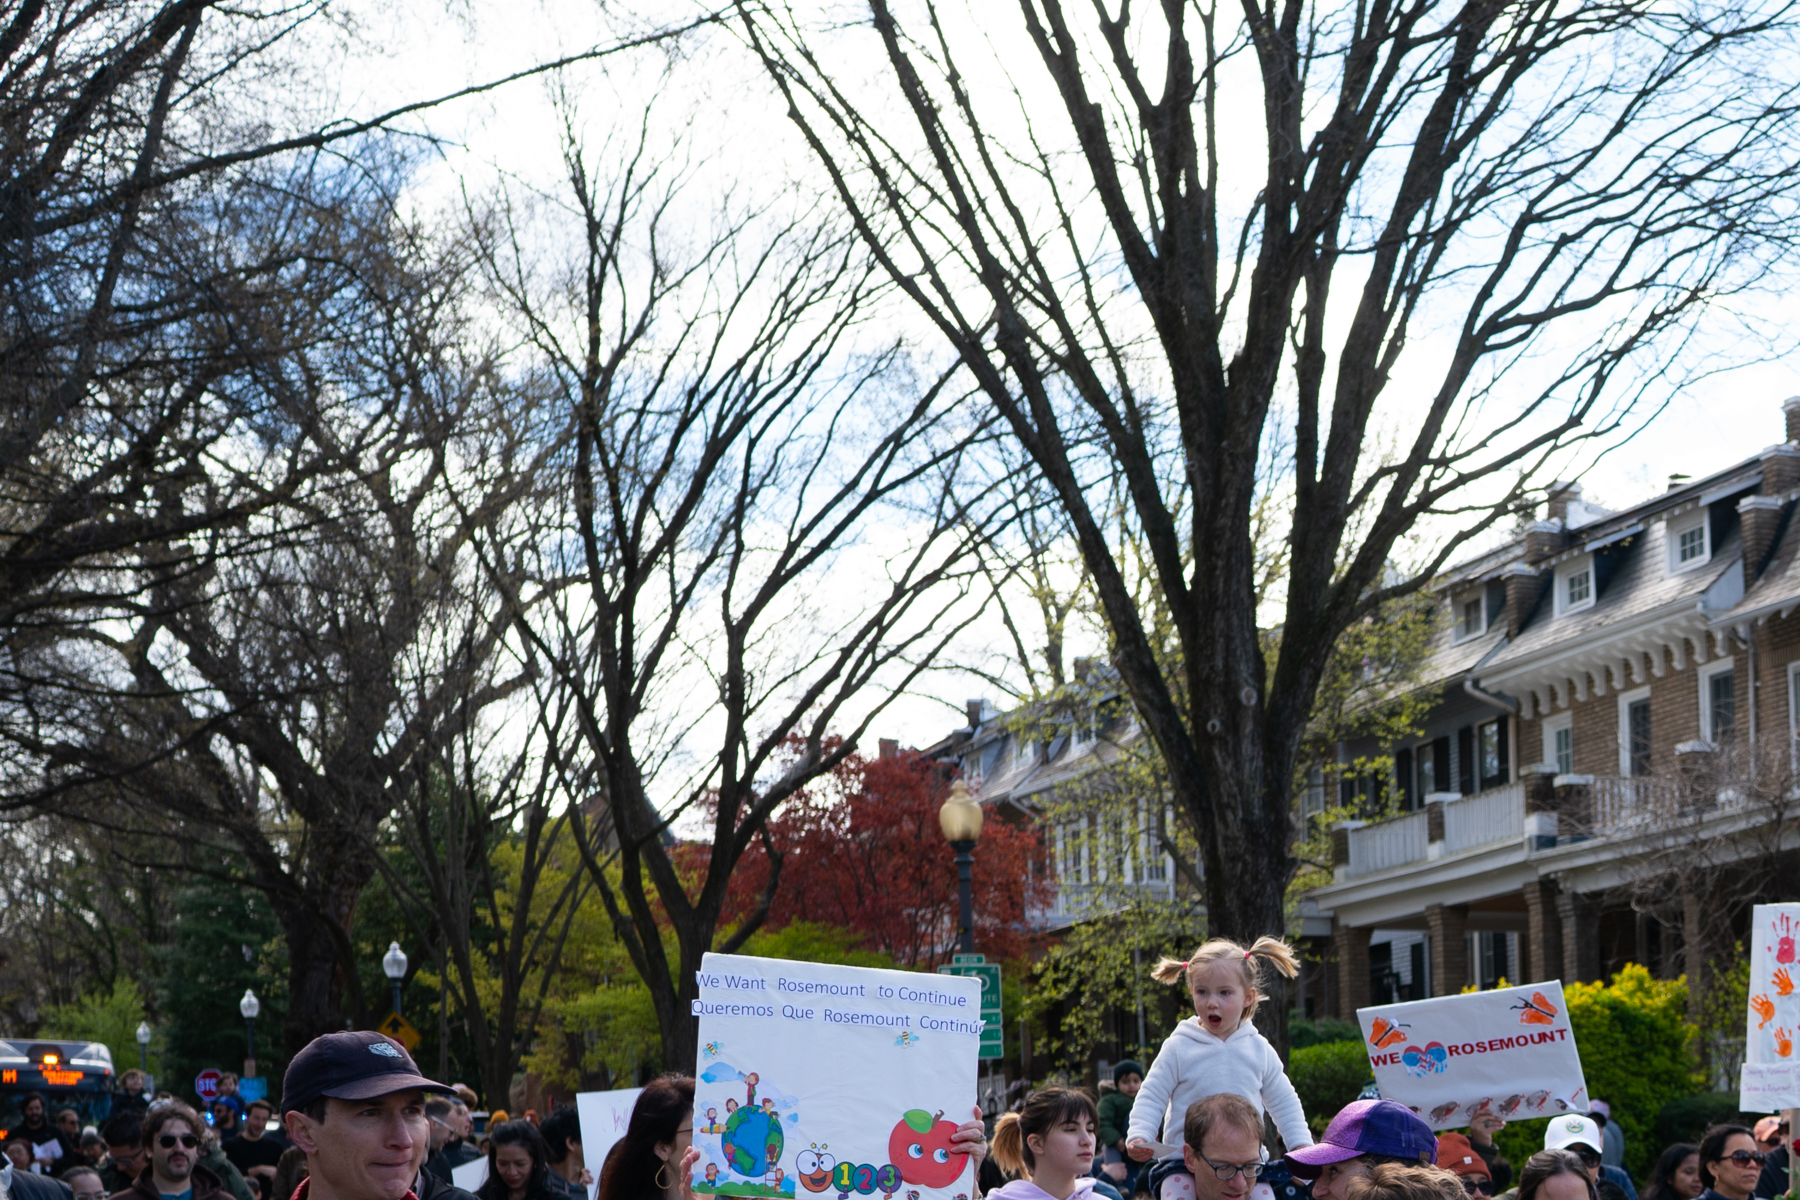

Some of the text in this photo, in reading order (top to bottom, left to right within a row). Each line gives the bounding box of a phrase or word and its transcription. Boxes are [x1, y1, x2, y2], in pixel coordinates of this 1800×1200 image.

[698, 974, 966, 1007] We Want Rosemount to Continue
[692, 1000, 774, 1016] Queremos
[782, 1005, 814, 1019] Que
[824, 1009, 911, 1028] Rosemount
[1371, 1028, 1567, 1067] WE ROSEMOUNT
